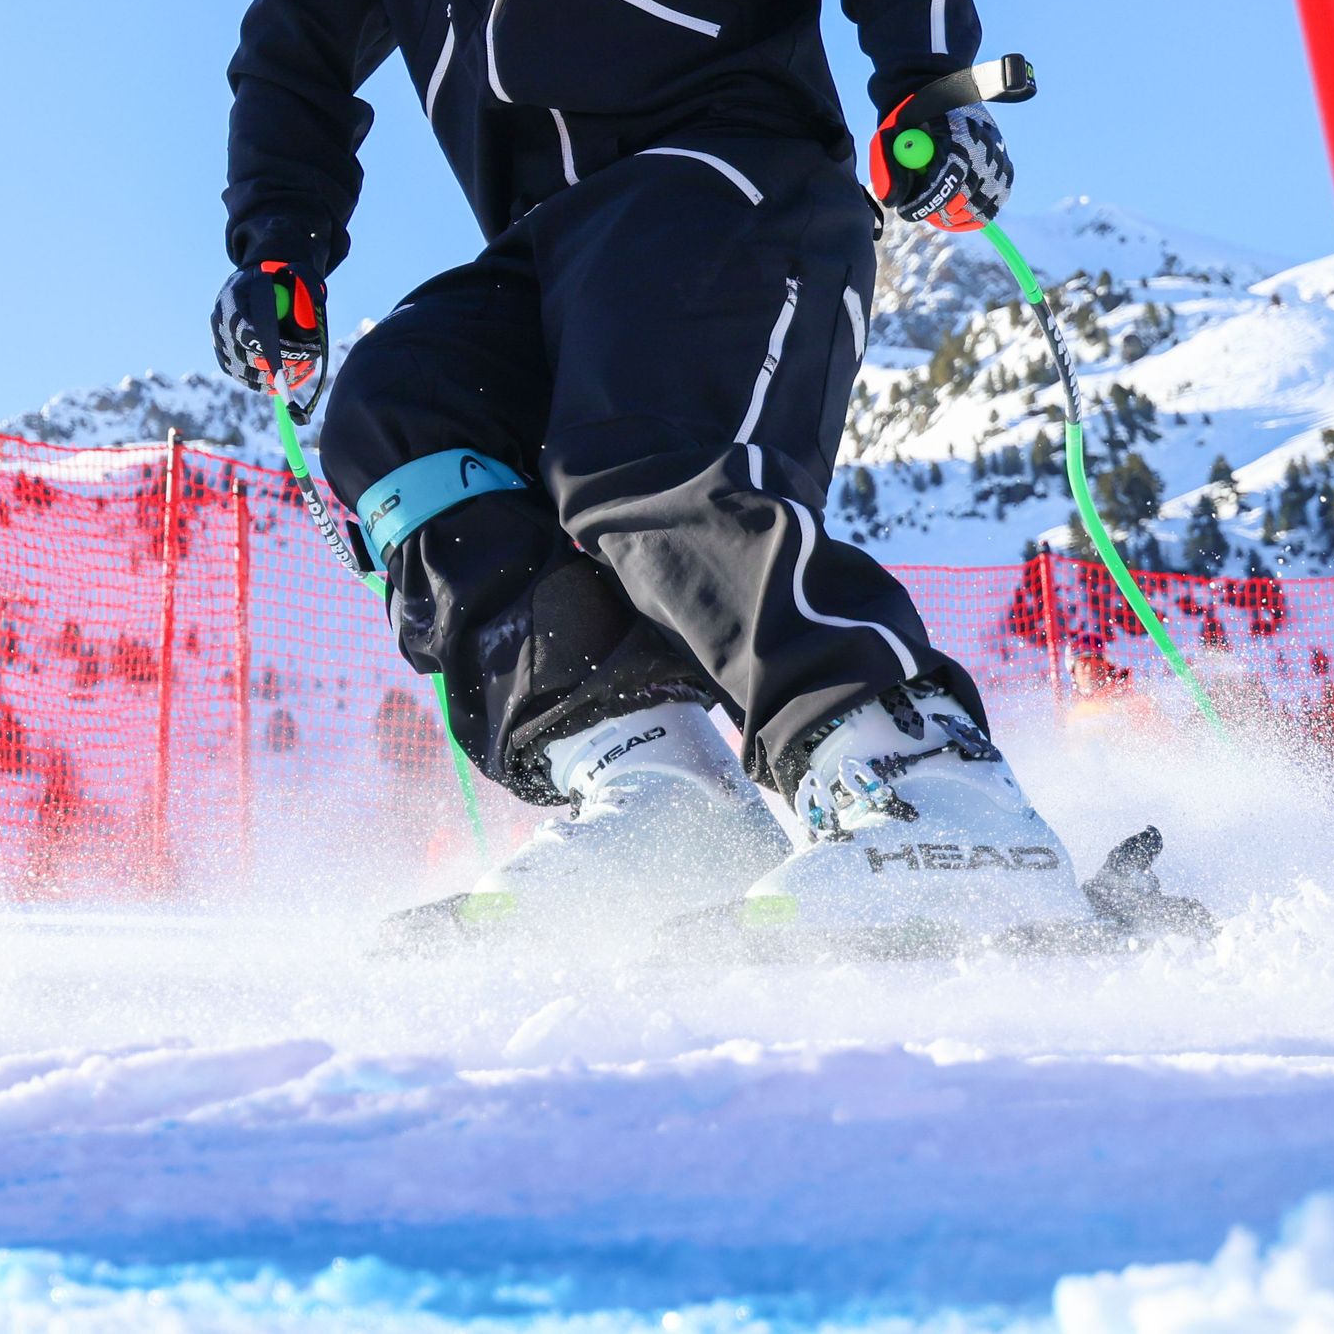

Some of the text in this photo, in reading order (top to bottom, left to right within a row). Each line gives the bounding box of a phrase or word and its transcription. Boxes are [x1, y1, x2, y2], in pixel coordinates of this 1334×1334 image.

[911, 173, 958, 220] reusch
[248, 338, 310, 361] rsch
[365, 494, 401, 539] EAD
[587, 726, 666, 781] HEAD
[864, 842, 1059, 873] HEAD
